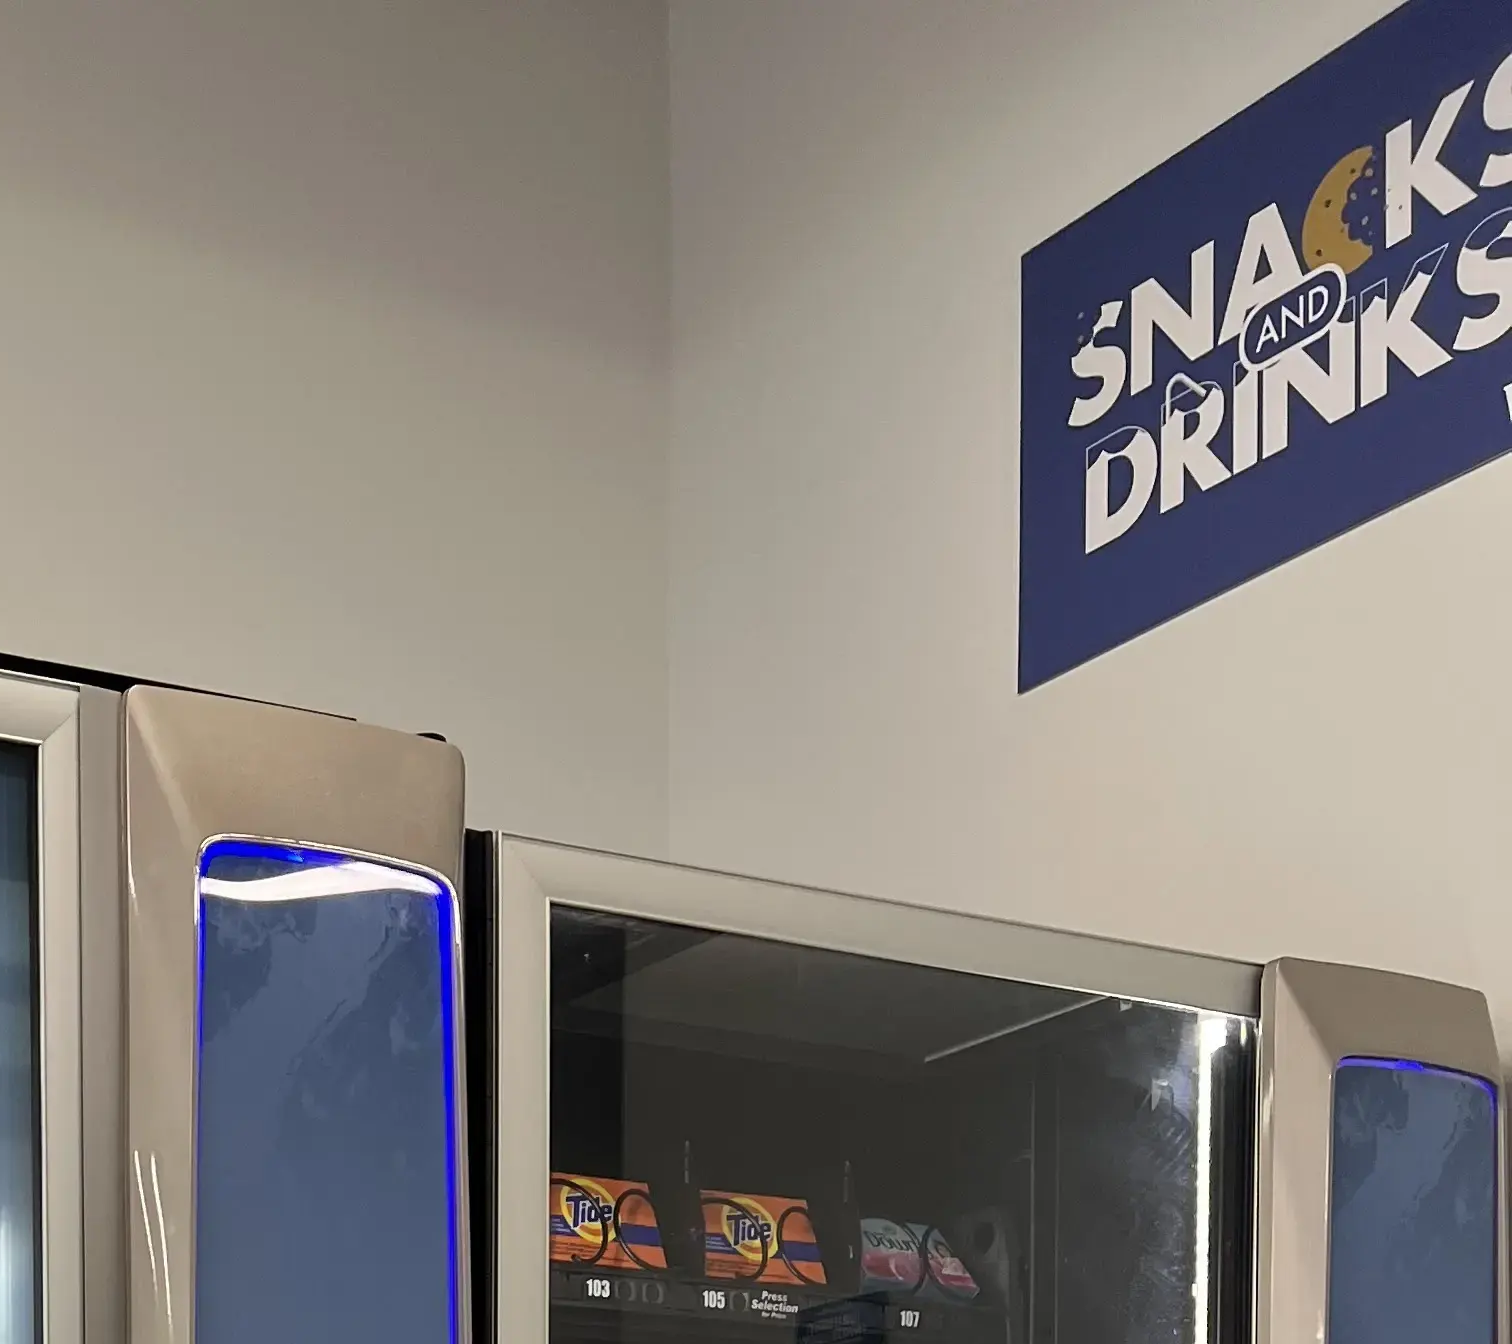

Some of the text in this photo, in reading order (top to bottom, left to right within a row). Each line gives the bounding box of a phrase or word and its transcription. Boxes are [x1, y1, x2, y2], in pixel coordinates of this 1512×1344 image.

[1255, 283, 1330, 354] AND
[1085, 205, 1512, 555] DRINKS
[565, 1191, 615, 1230] Tide
[725, 1210, 772, 1248] Tide
[586, 1278, 611, 1298] 103
[761, 1290, 788, 1302] Press
[702, 1290, 726, 1309] 105
[751, 1299, 799, 1314] Selection
[899, 1310, 920, 1328] 107
